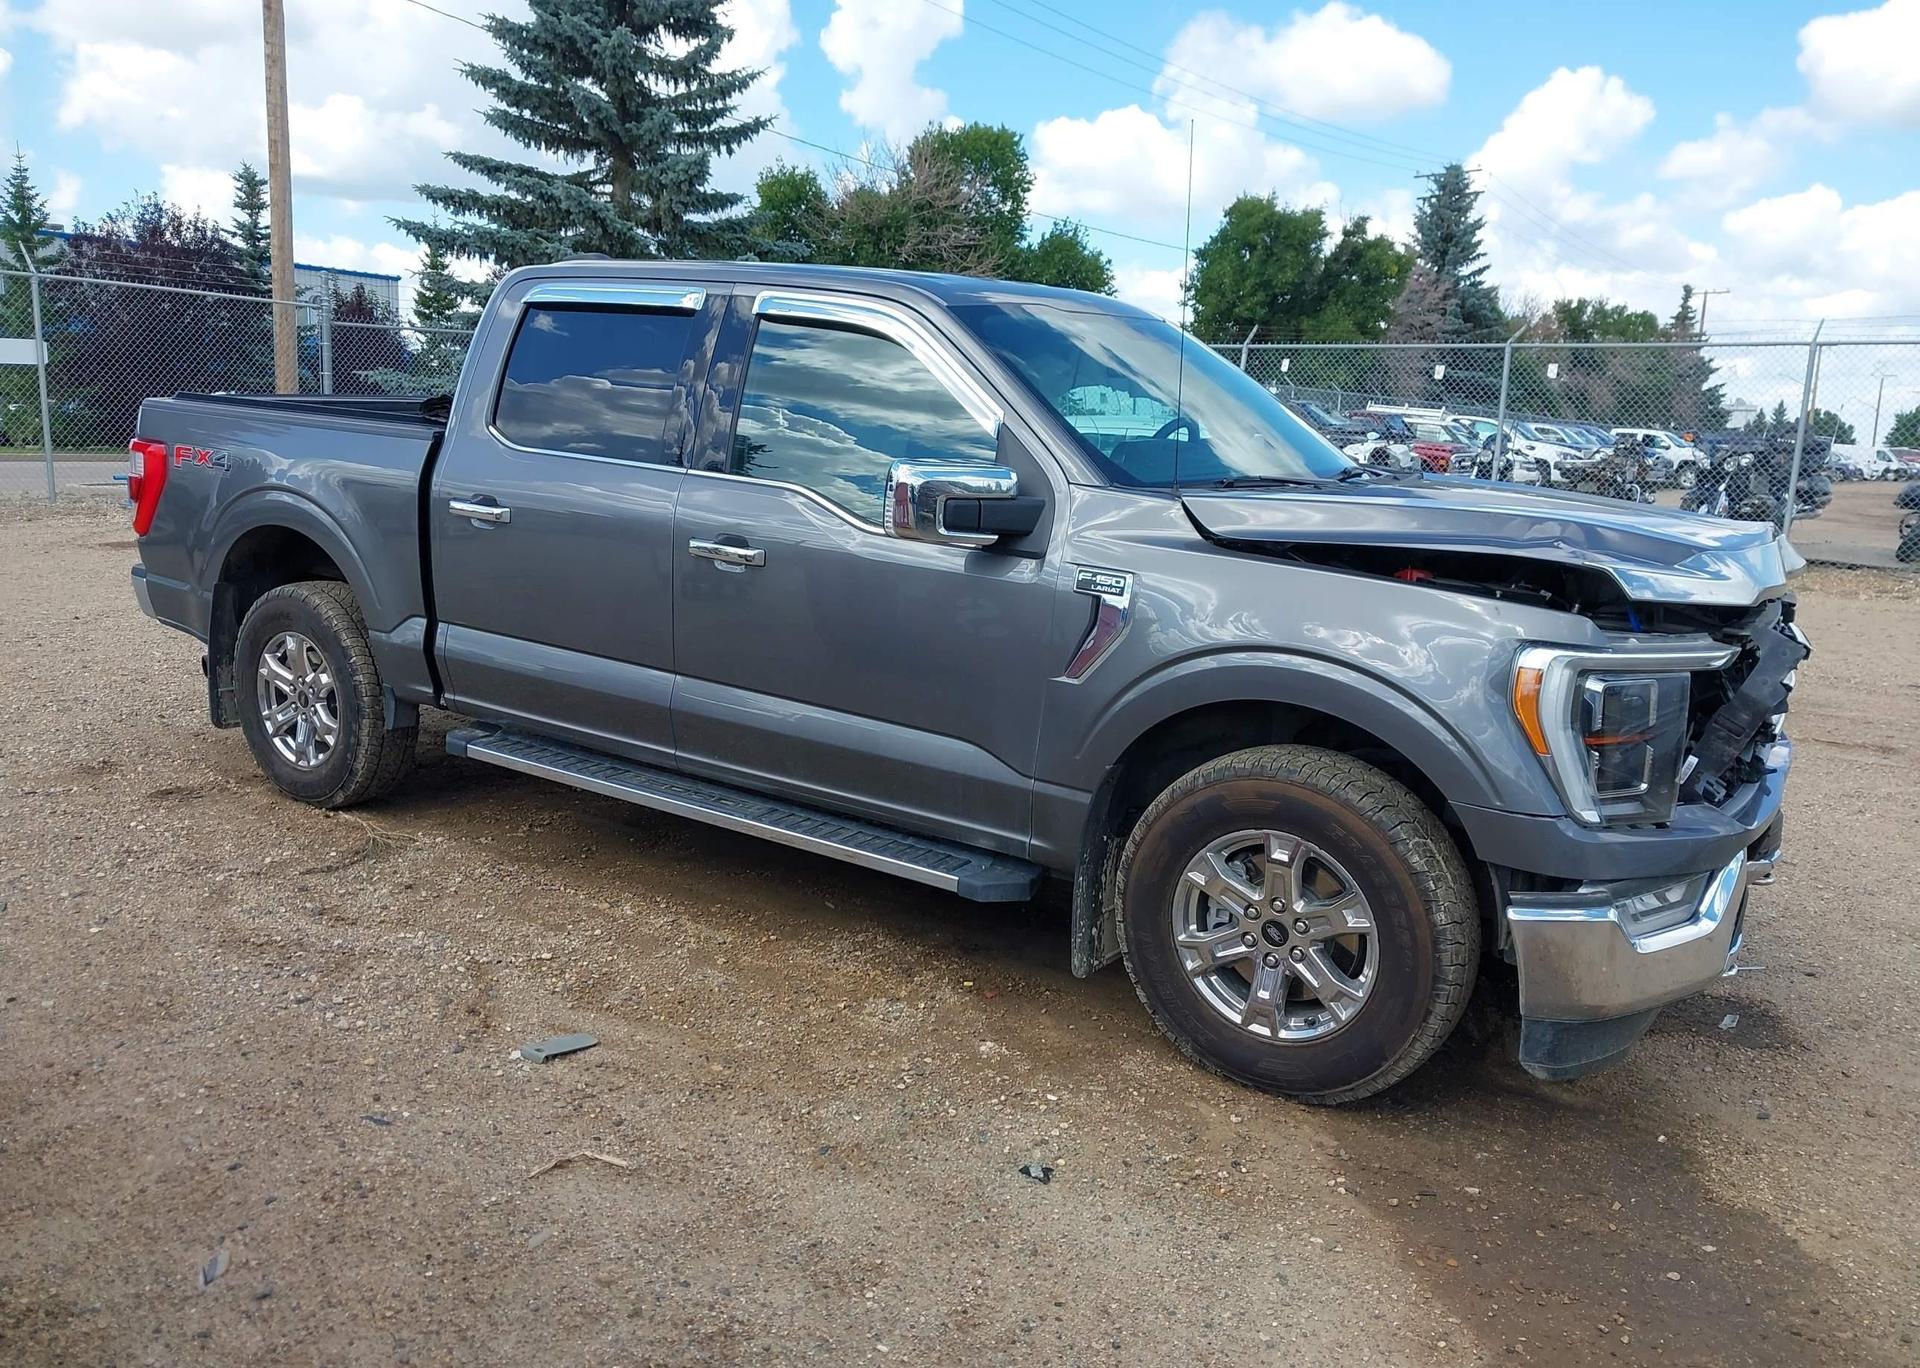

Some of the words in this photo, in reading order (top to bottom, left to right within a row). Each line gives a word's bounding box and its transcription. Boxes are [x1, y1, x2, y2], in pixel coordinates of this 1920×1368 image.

[174, 444, 232, 472] FX4
[1078, 572, 1125, 587] F-150
[1091, 584, 1121, 594] LARIAT
